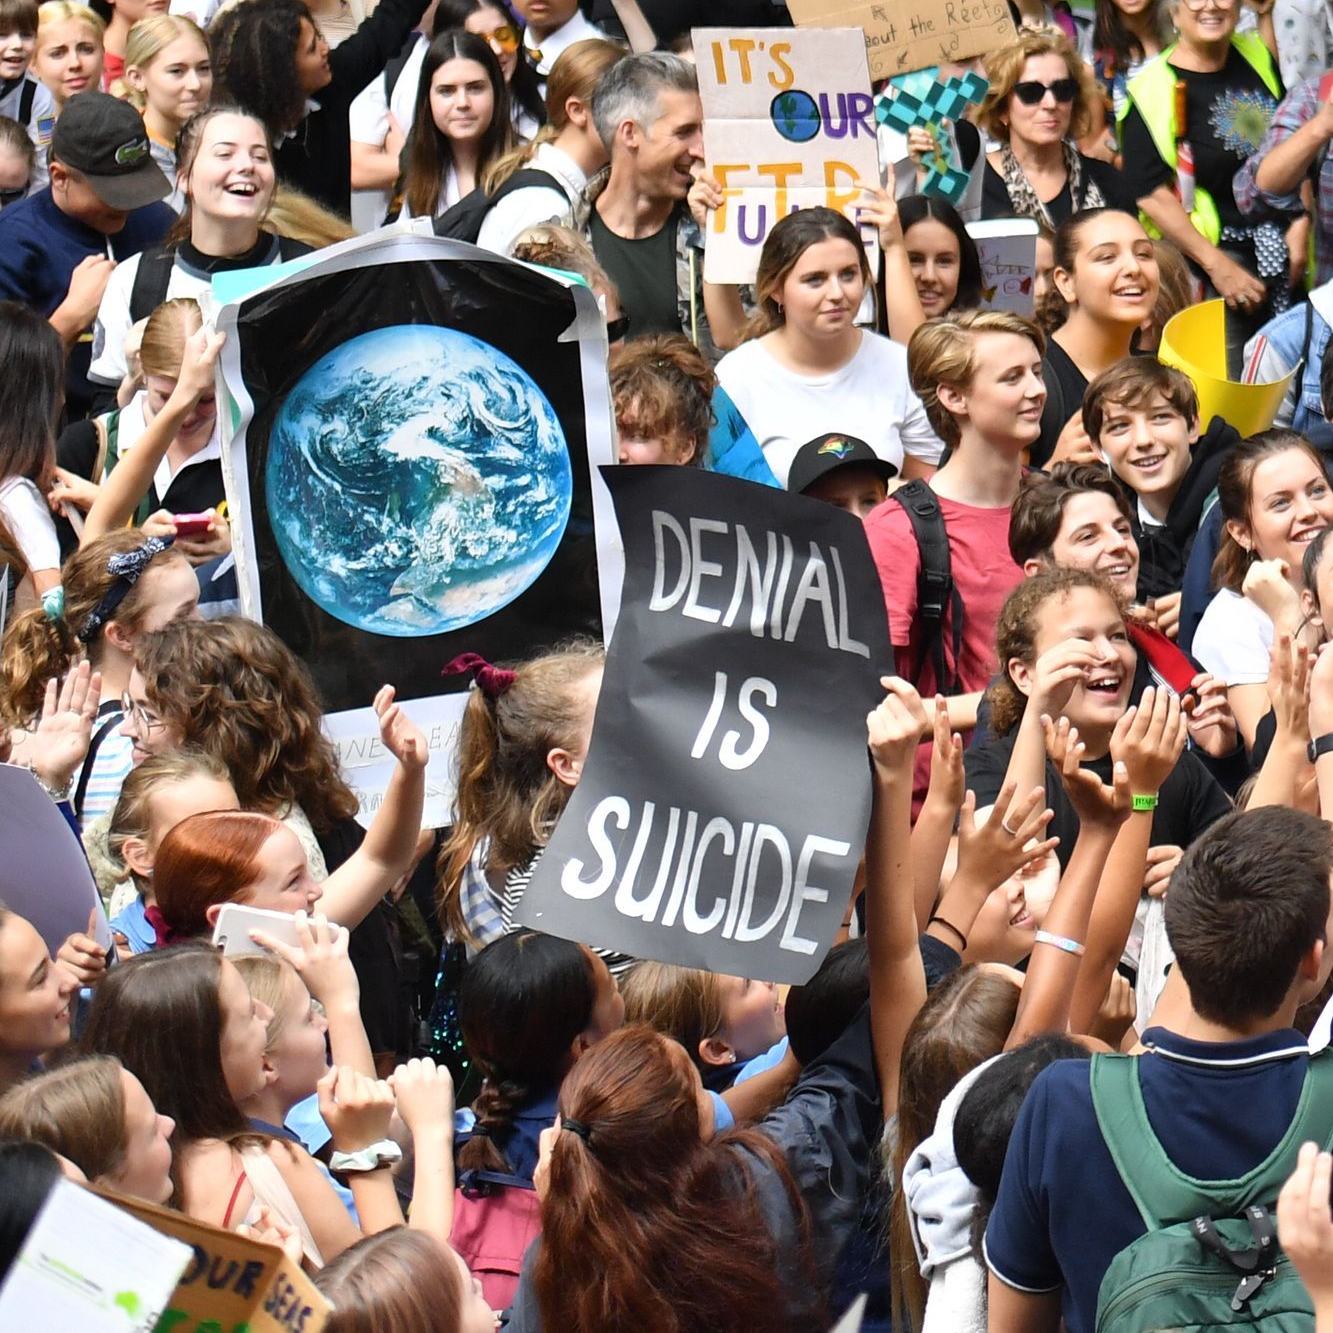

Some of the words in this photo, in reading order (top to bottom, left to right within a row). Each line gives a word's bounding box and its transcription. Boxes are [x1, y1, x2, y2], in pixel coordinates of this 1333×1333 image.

[711, 38, 796, 91] IT'S
[909, 13, 936, 37] the
[649, 509, 871, 660] DENIAL
[690, 670, 778, 771] IS
[560, 794, 852, 956] SUICIDE
